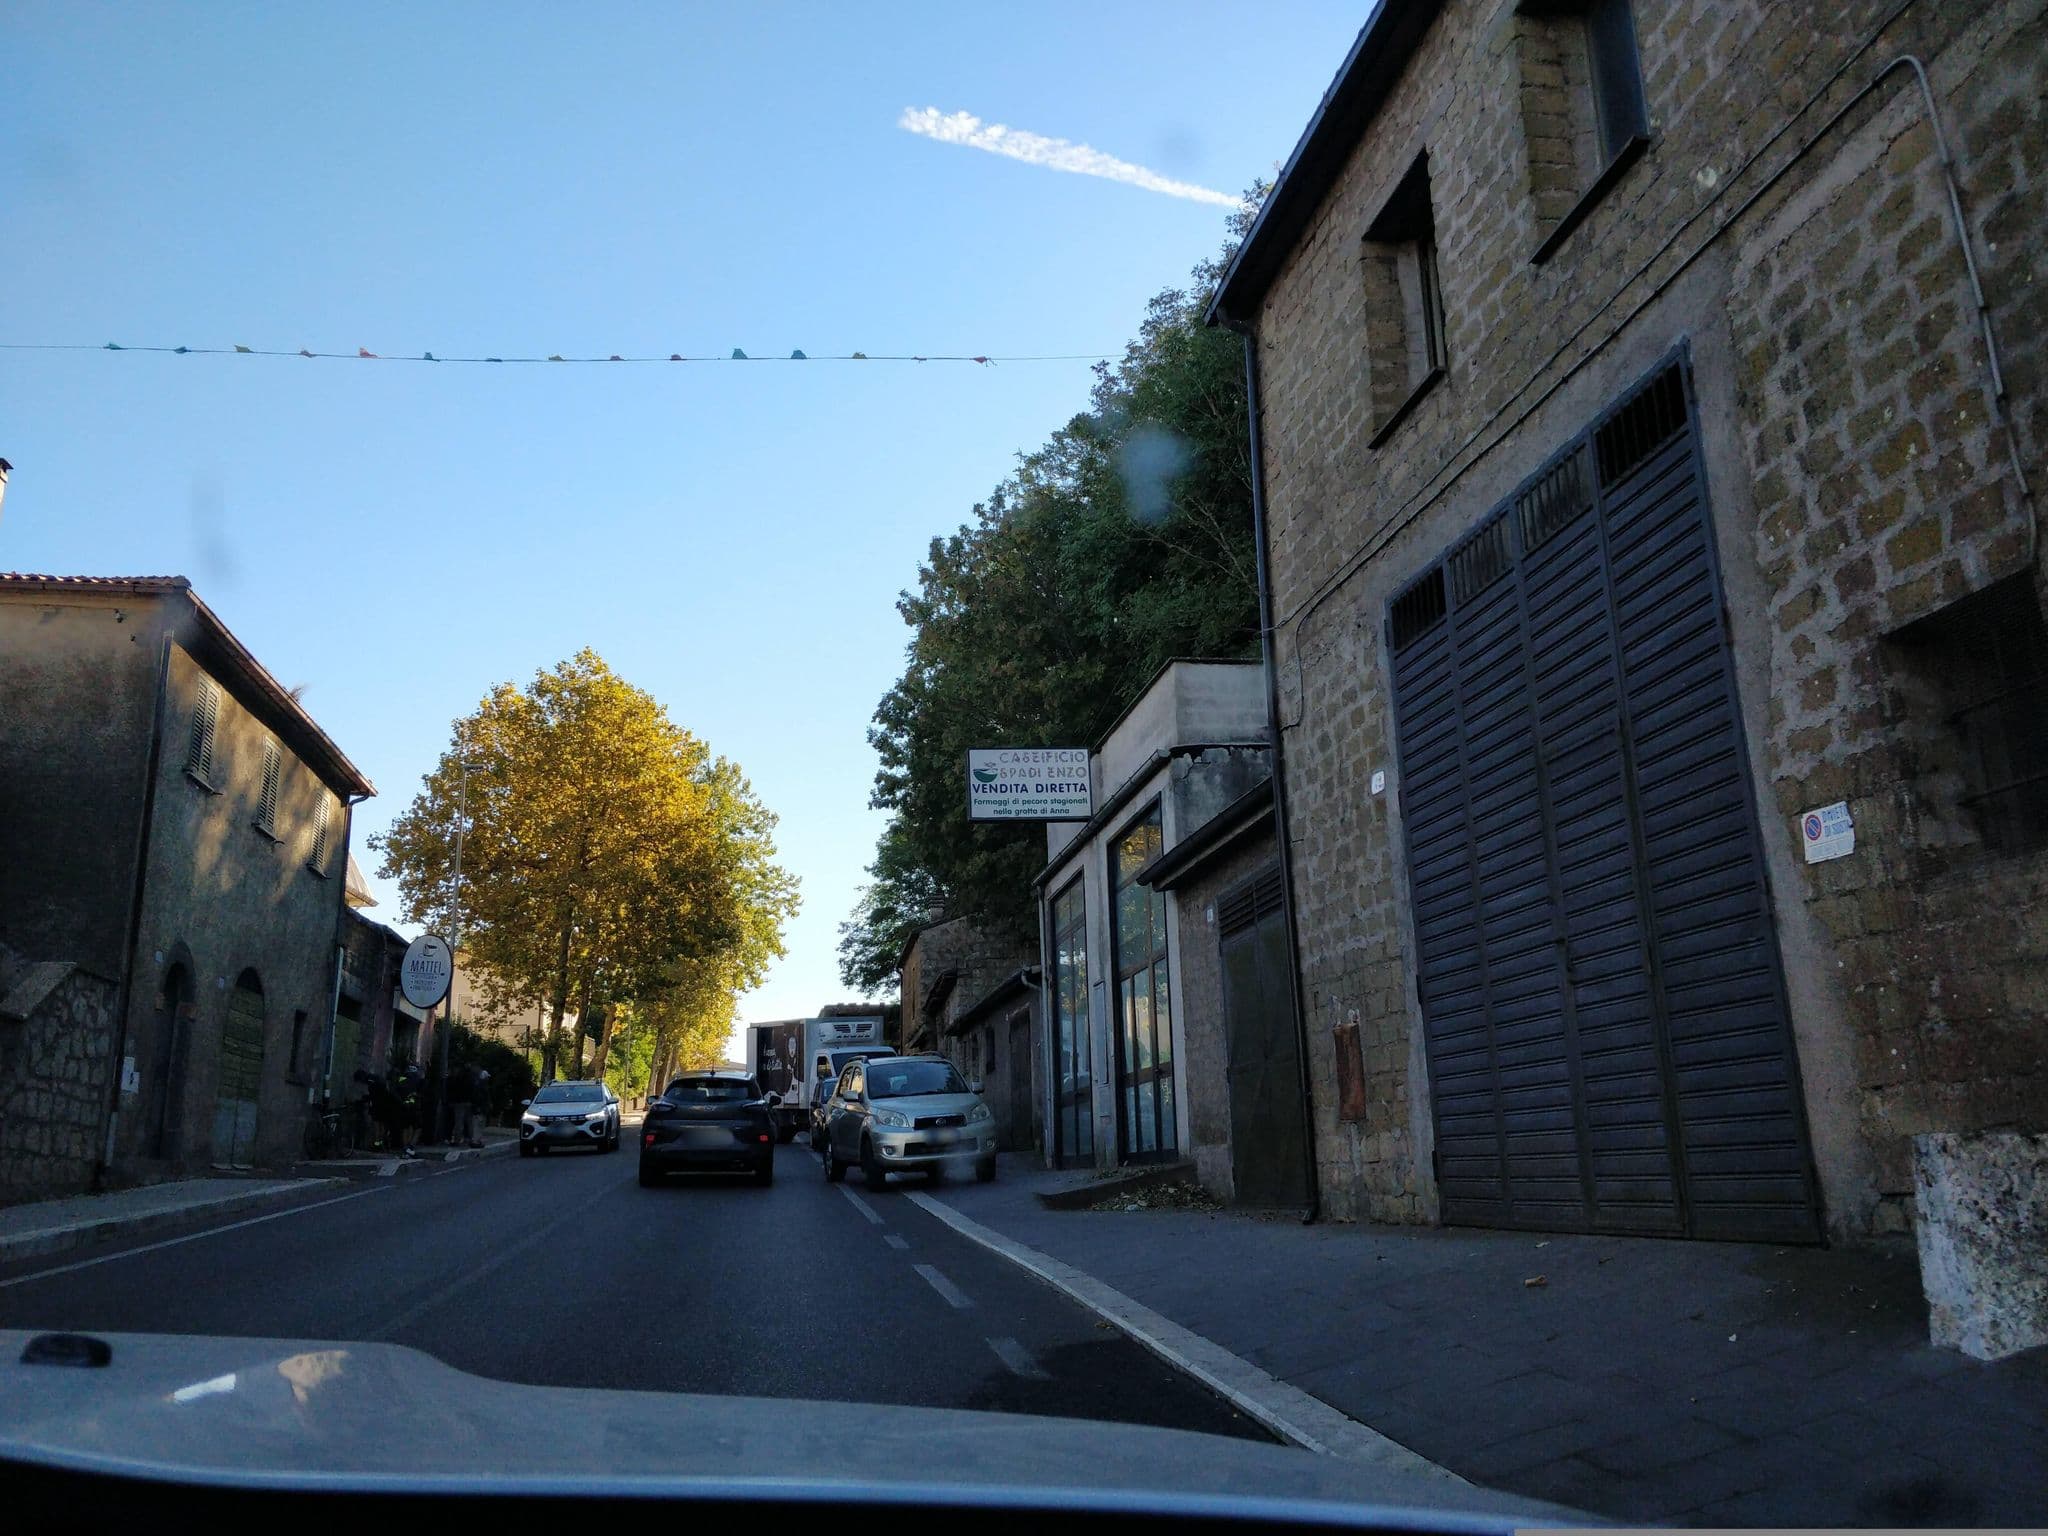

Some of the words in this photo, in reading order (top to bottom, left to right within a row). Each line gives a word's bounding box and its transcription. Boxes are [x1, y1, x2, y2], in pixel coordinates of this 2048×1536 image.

[1000, 751, 1086, 763] CASEIFICIO
[1000, 767, 1041, 779] SPADI
[1047, 766, 1087, 778] ENZO
[972, 783, 1029, 794] VENDITA
[1035, 782, 1087, 793] DIRETTA
[974, 798, 1010, 807] Formaggi
[1022, 799, 1048, 807] pecora
[1050, 797, 1088, 807] stagionati
[1014, 808, 1038, 816] grotta
[410, 960, 442, 973] MATTEI
